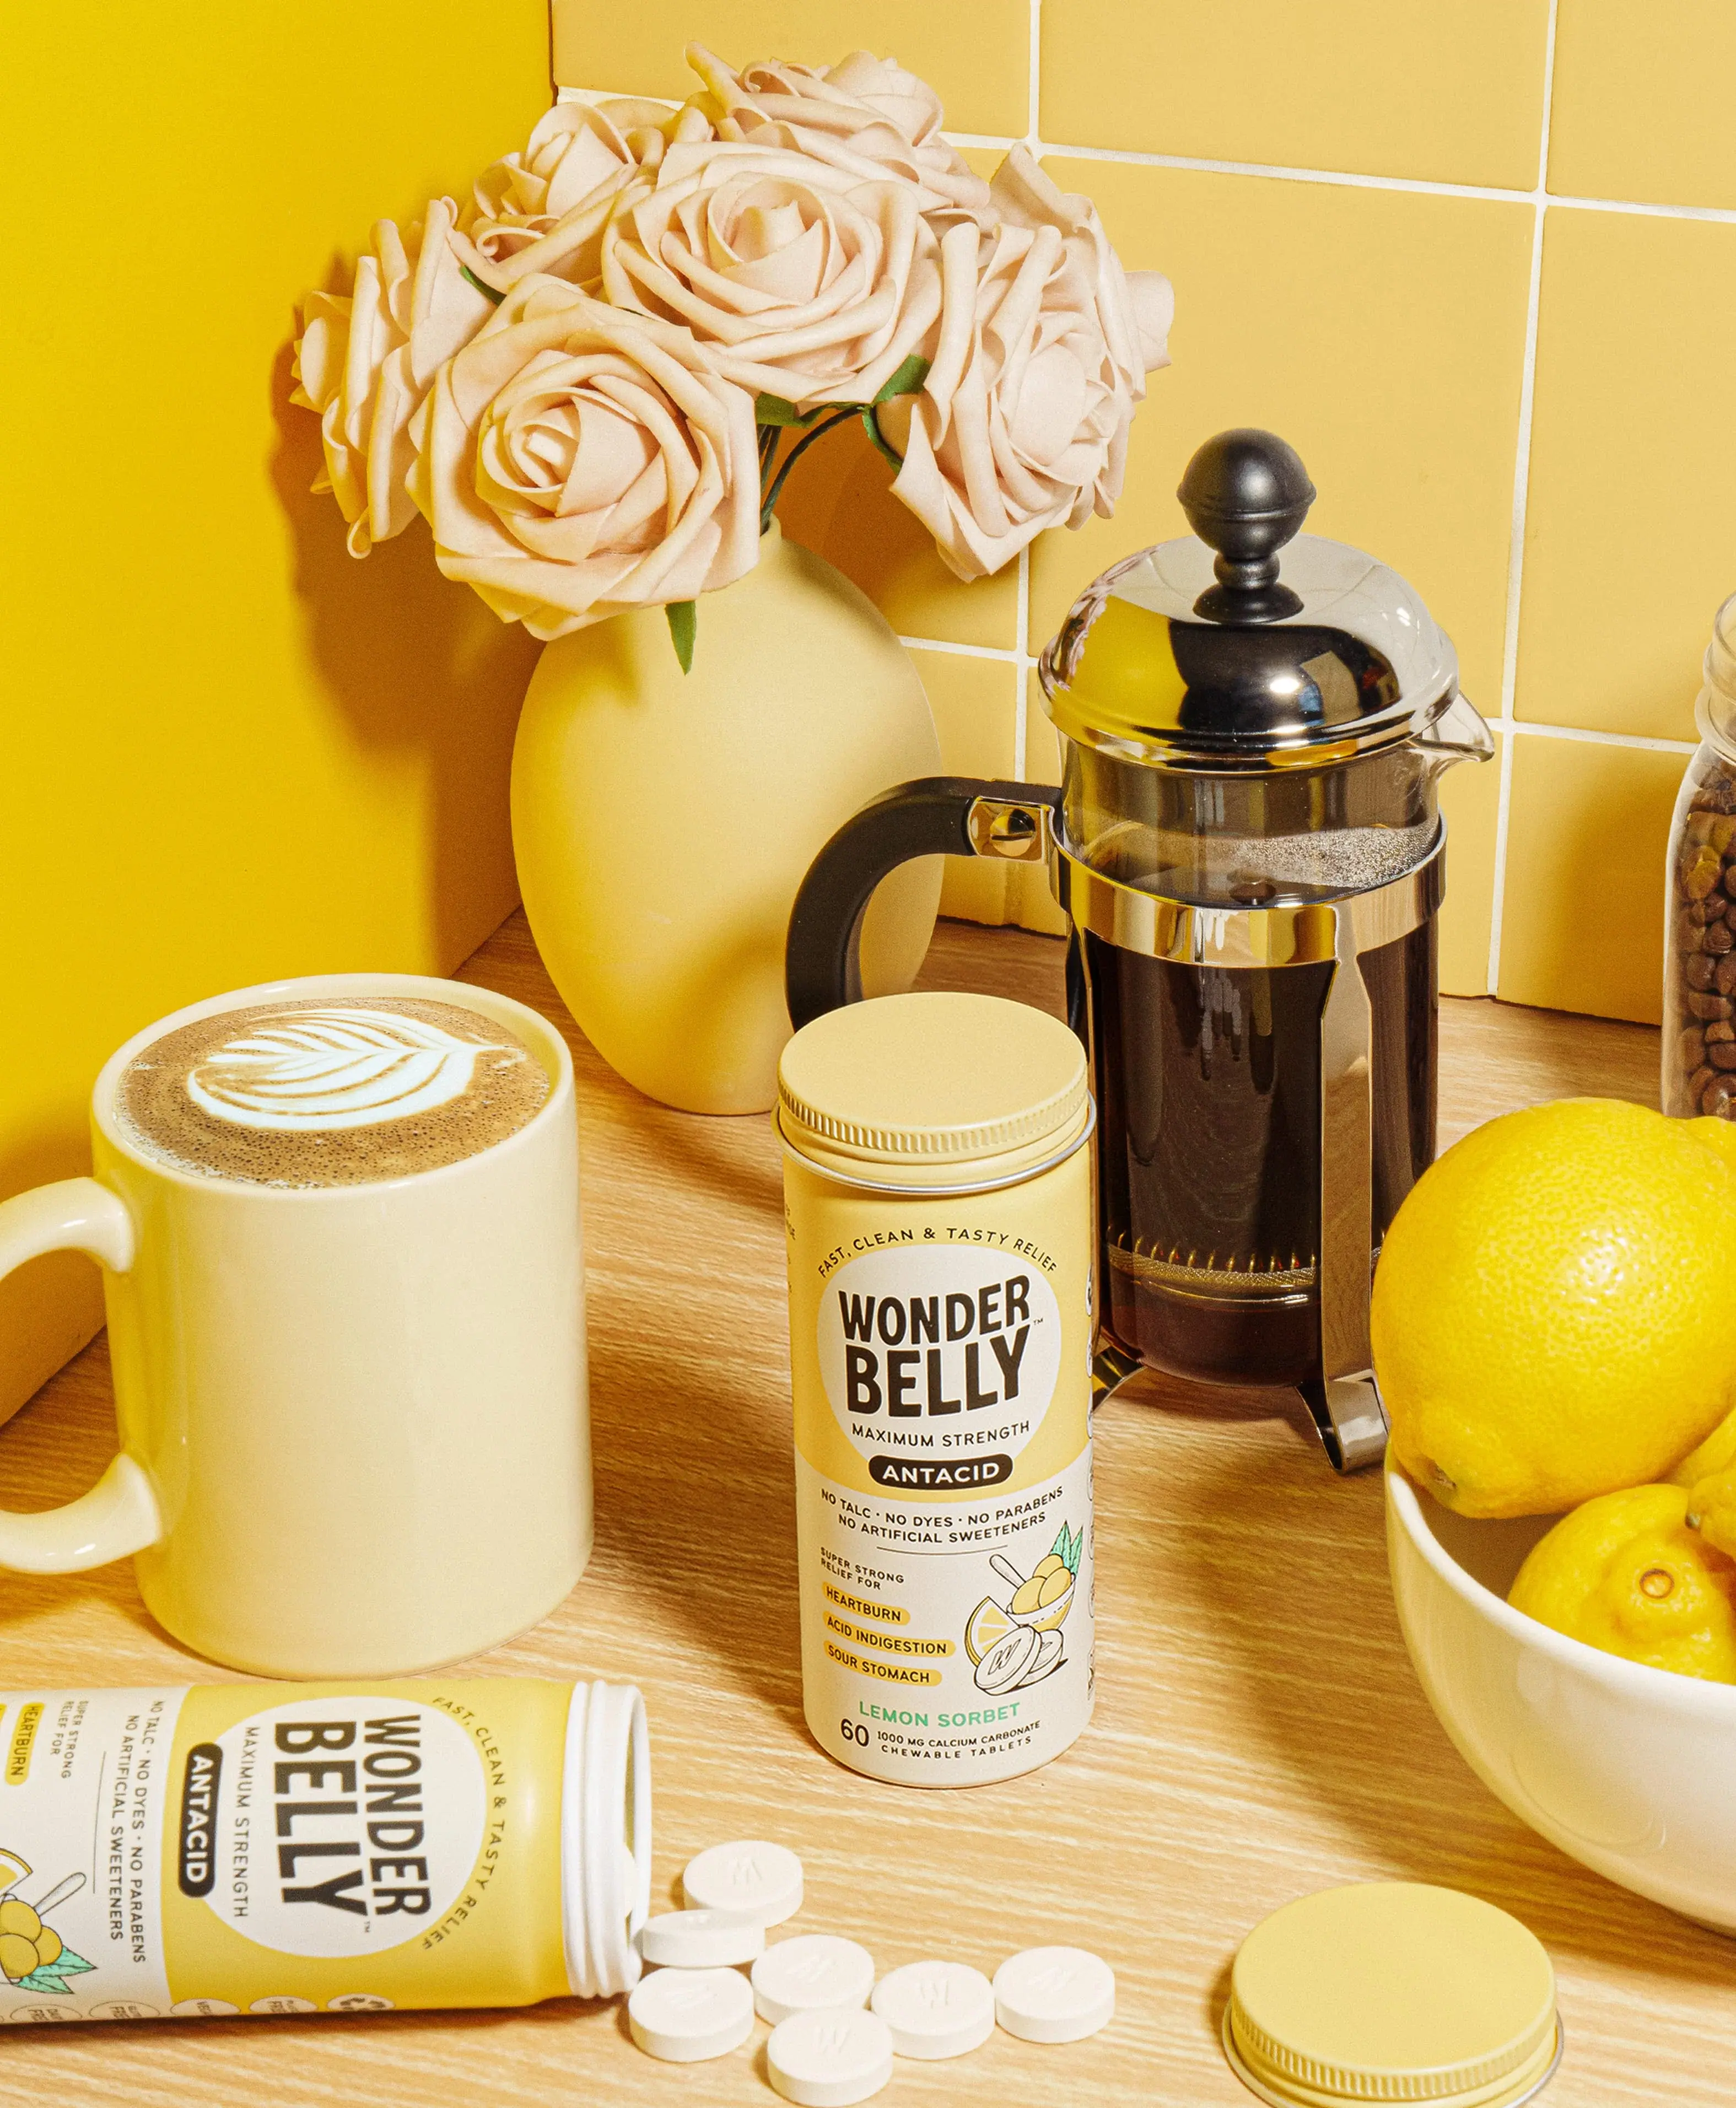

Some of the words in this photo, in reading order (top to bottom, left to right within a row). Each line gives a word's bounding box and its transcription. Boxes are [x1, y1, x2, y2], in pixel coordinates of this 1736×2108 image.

[817, 1247, 851, 1277] FAST,
[853, 1229, 913, 1250] CLEAN
[923, 1228, 935, 1239] &
[946, 1227, 1009, 1244] TASTY
[1013, 1238, 1057, 1272] RELIEF
[838, 1275, 1030, 1346] WONDER
[845, 1324, 1030, 1417] BELLY
[852, 1422, 934, 1447] MAXIMUM
[942, 1420, 1029, 1447] STRENGTH
[882, 1462, 1000, 1484] ANTACID
[821, 1489, 836, 1505] NO
[840, 1498, 871, 1518] TALC
[886, 1512, 907, 1525] NO
[913, 1516, 953, 1528] DYES
[968, 1513, 989, 1525] NO
[996, 1486, 1063, 1521] PARABENS
[839, 1514, 856, 1529] NO
[861, 1523, 942, 1543] ARTIFICIAL
[948, 1511, 1045, 1543] SWEETENERS
[821, 1547, 850, 1569] SUPER
[855, 1565, 904, 1583] STRONG
[821, 1558, 853, 1580] RELIEF
[858, 1577, 881, 1590] FOR
[827, 1586, 901, 1622] HEARTBURN
[828, 1616, 852, 1636] ACID
[856, 1630, 947, 1654] INDIGESTION
[828, 1645, 858, 1669] SOUR
[862, 1661, 930, 1683] STOMACH
[57, 1701, 74, 1728] RELIEF
[72, 1701, 88, 1726] SUPER
[125, 1715, 139, 1731] NO
[150, 1700, 164, 1713] NO
[432, 1696, 475, 1726] FAST,
[859, 1701, 929, 1727] LEMON
[938, 1702, 1020, 1727] SORBET
[10, 1706, 39, 1776] HEARTBURN
[50, 1733, 64, 1755] FOR
[142, 1716, 160, 1745] TALC
[840, 1718, 869, 1747] 60
[877, 1730, 904, 1744] 1000
[908, 1738, 924, 1746] MG
[929, 1738, 977, 1747] CALCIUM
[981, 1721, 1040, 1744] CARBONATE
[881, 1745, 961, 1759] CHEWABLE
[972, 1736, 1032, 1757] TABLETS
[61, 1730, 79, 1779] STRONG
[137, 1759, 151, 1781] NO
[234, 1727, 260, 1808] MAXIMUM
[476, 1727, 506, 1786] CLEAN
[111, 1735, 135, 1819] ARTIFICIAL
[132, 1787, 147, 1830] DYES
[186, 1756, 214, 1883] ANTACID
[273, 1721, 369, 1918] BELLY
[363, 1713, 432, 1916] WONDER
[493, 1797, 507, 1808] &
[130, 1846, 143, 1871] NO
[233, 1818, 250, 1918] STRENGTH
[476, 1819, 506, 1891] TASTY
[109, 1825, 123, 1941] SWEETENERS
[130, 1879, 146, 1963] PARABENS
[422, 1894, 478, 1950] RELIEF
